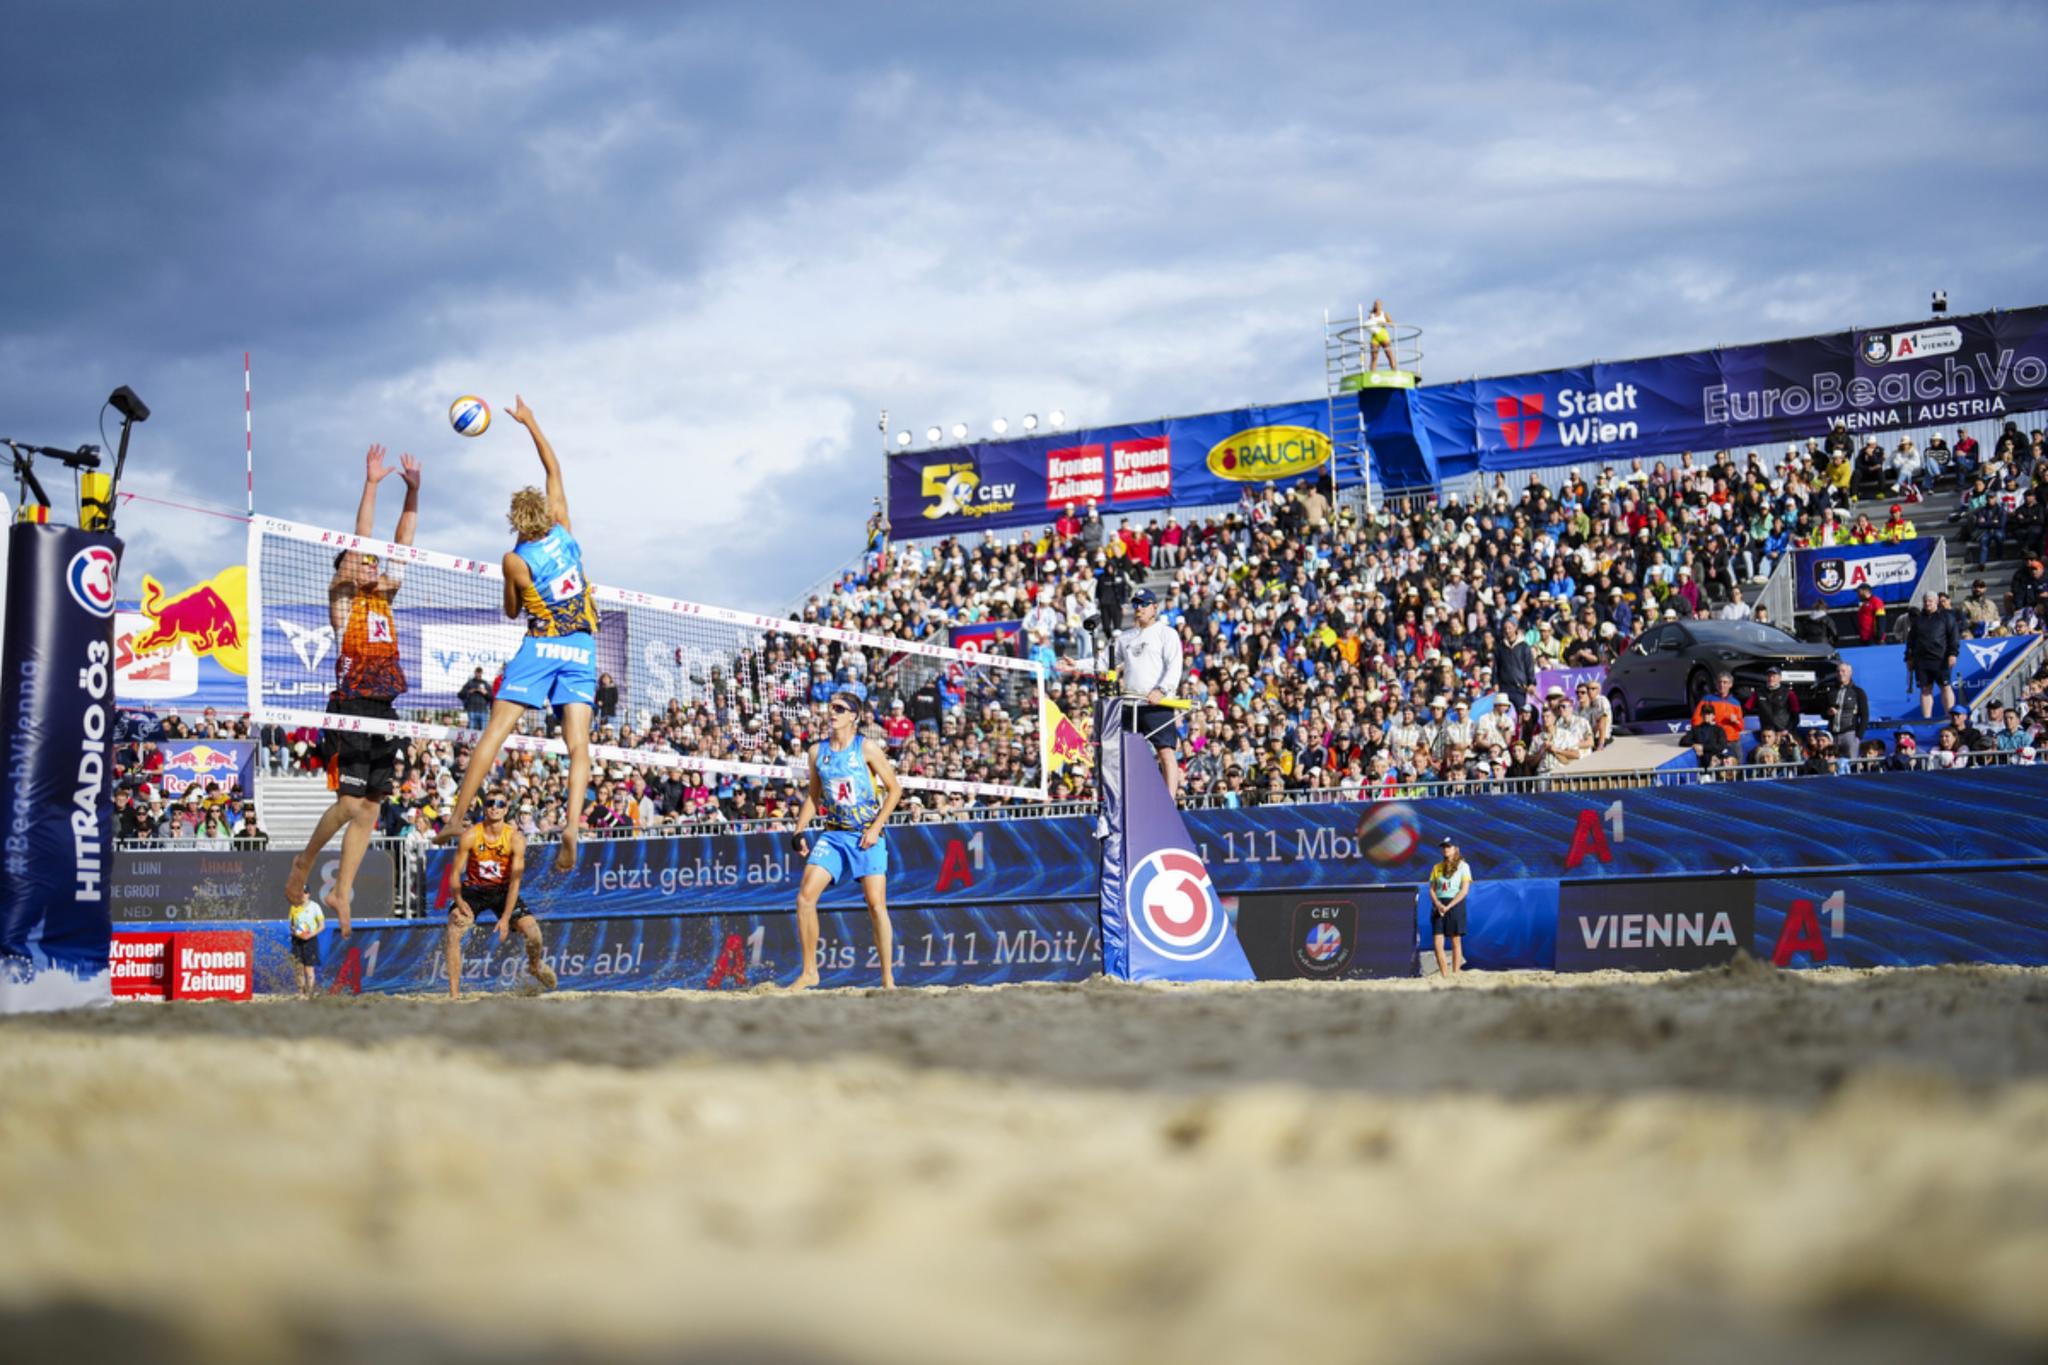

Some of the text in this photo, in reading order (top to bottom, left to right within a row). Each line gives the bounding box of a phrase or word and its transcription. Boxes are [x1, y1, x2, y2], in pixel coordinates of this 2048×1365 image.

[1897, 333, 1918, 357] A1
[1921, 340, 1955, 351] VIENNA
[1557, 382, 1638, 418] Stadt
[1827, 396, 2006, 431] VIENNA AUSTRIA
[1557, 417, 1638, 447] Wien
[1113, 447, 1169, 471] Kronen
[1239, 439, 1317, 468] RAUCH
[1050, 455, 1104, 479] Kronen
[978, 483, 1017, 500] CEV
[1050, 476, 1104, 500] Zeitung
[1113, 468, 1170, 492] Zeitung
[962, 499, 1014, 518] Together
[1850, 562, 1871, 585] A1
[1875, 569, 1910, 579] VIENNA
[535, 642, 592, 665] THULE
[79, 640, 109, 699] Ö3
[5, 660, 37, 875] #BeachVienna
[71, 704, 106, 900] HITRADIO
[838, 781, 852, 801] A1
[1223, 830, 1282, 863] 111
[1564, 800, 1625, 869] A1
[131, 861, 162, 875] LUINI
[936, 831, 984, 892] A1
[593, 854, 791, 895] Jetzt gehts ab!
[124, 884, 161, 897] GROOT
[123, 905, 153, 918] NED
[1311, 907, 1339, 919] CEV
[1578, 912, 1737, 950] VIENNA
[1771, 890, 1846, 968] A1
[181, 948, 246, 969] Kronen
[593, 943, 644, 975] ab!
[706, 925, 765, 989] A1
[919, 933, 984, 967] 111
[109, 960, 164, 978] Zeitung
[329, 940, 381, 994] A1
[181, 971, 246, 994] Zeitung
